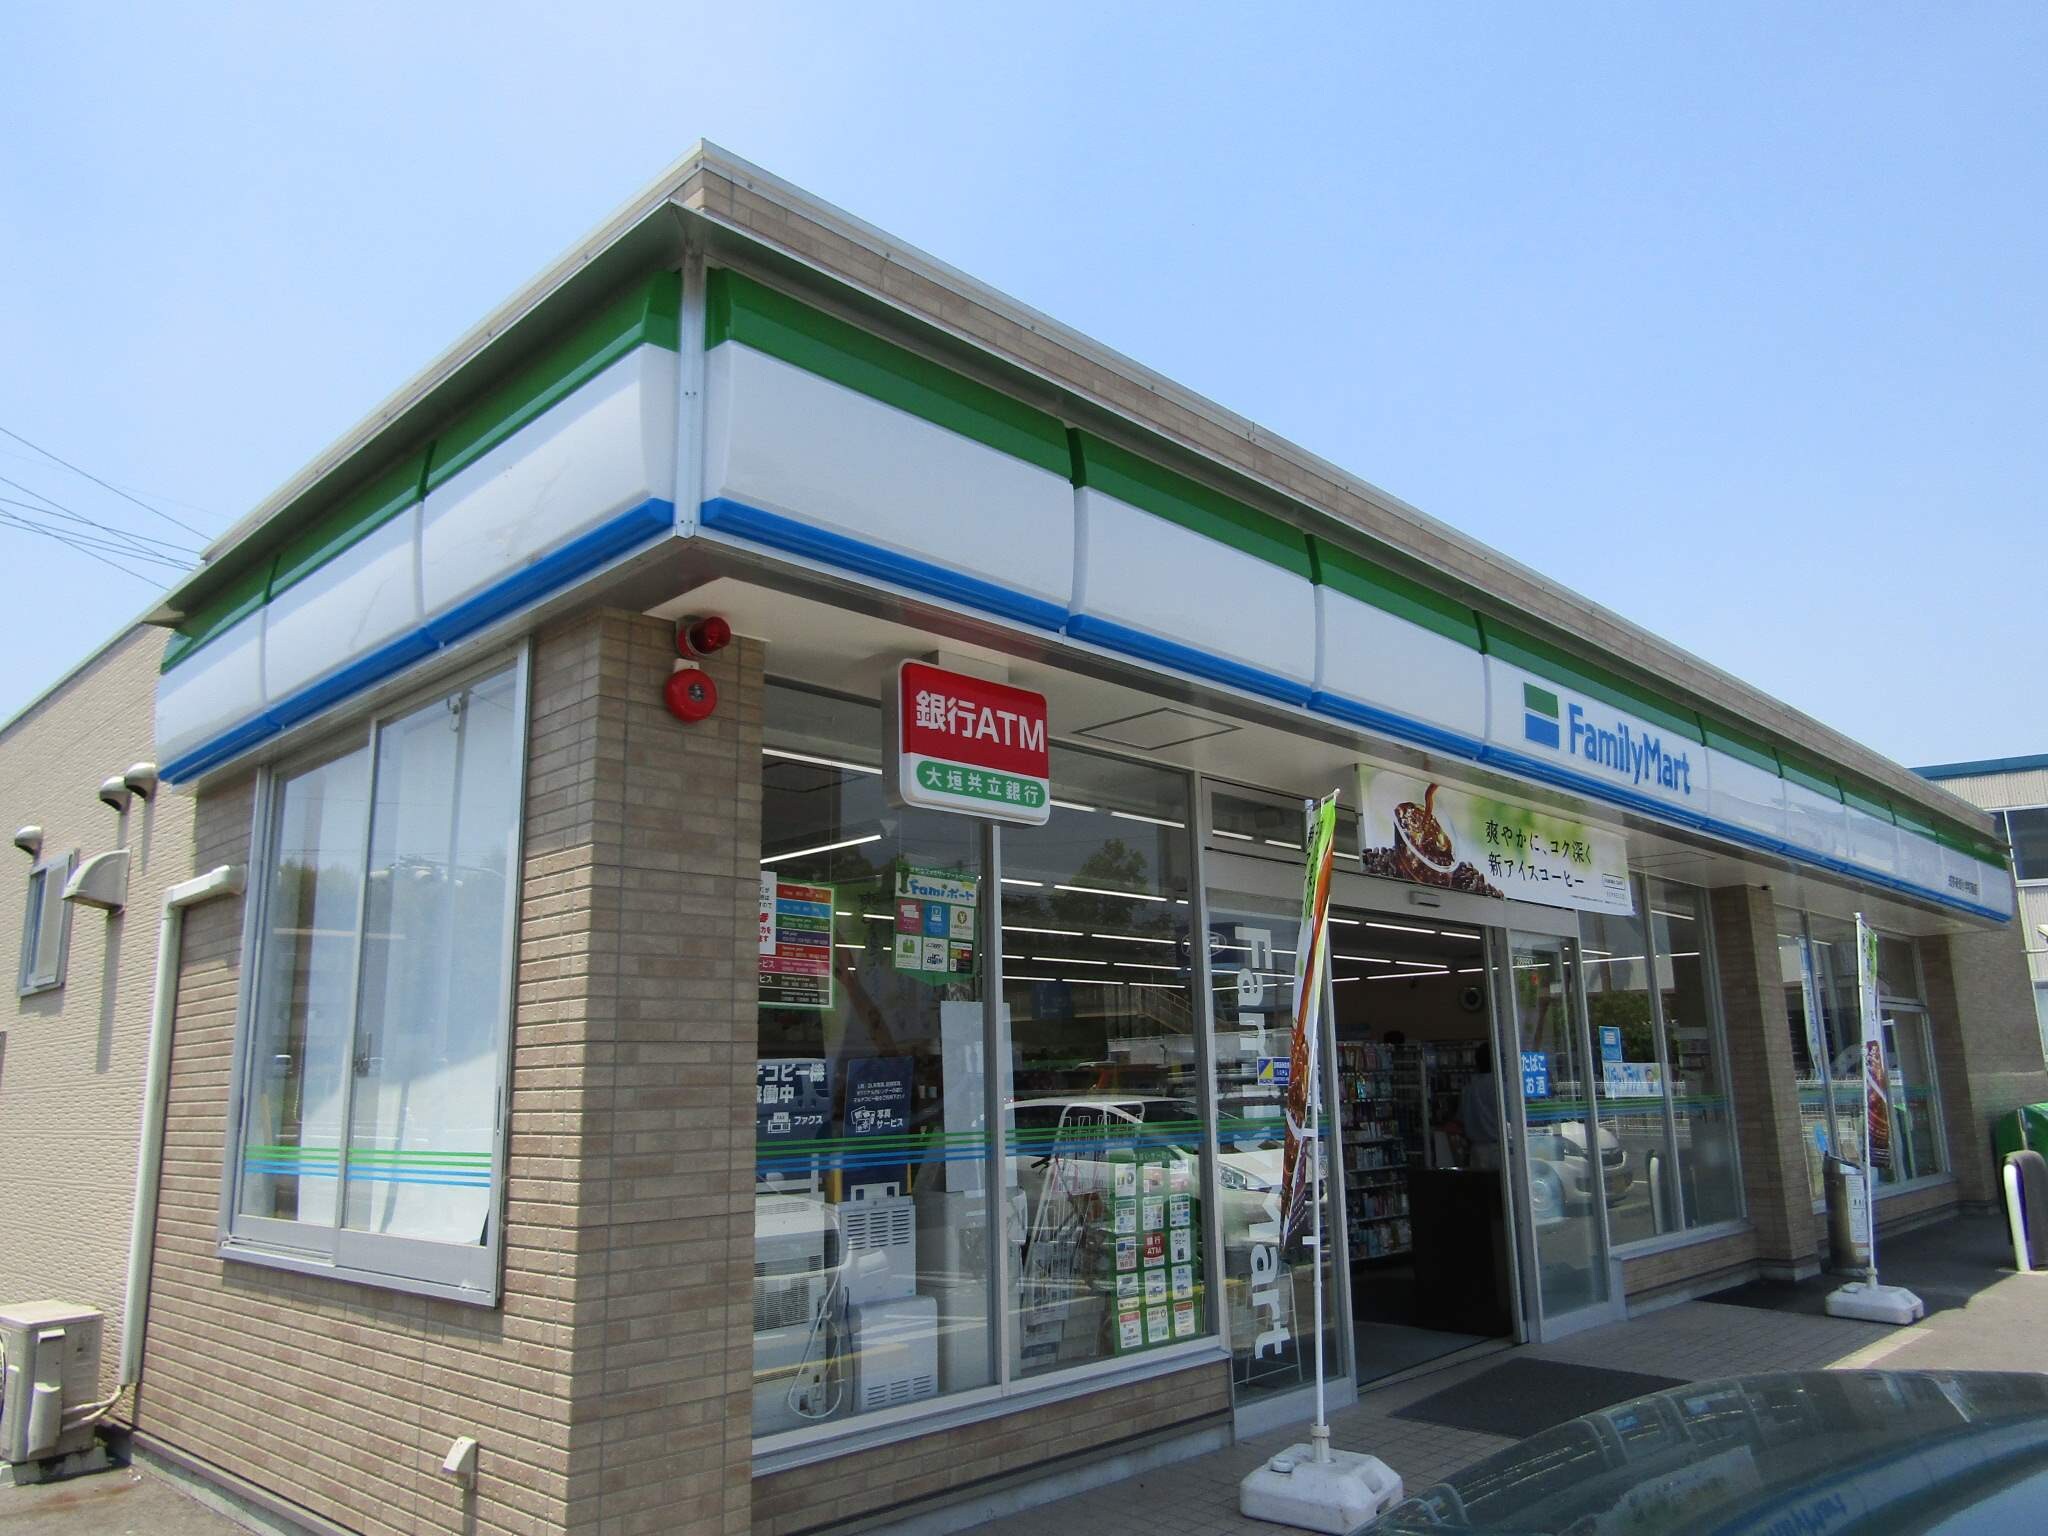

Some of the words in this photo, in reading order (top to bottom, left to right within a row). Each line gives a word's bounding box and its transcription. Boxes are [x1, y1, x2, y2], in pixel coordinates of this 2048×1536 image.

[916, 690, 1045, 753] 銀行ATM
[1568, 703, 1690, 795] FamilyMart
[925, 766, 1038, 805] 大垣共立銀行
[1485, 819, 1592, 865] 爽やかに、コク深く
[1487, 852, 1585, 888] 新アイスコーヒー
[1521, 1054, 1547, 1073] たばこ
[1525, 1076, 1546, 1094] お酒
[876, 1117, 904, 1129] サービス
[1146, 1246, 1162, 1255] ATM
